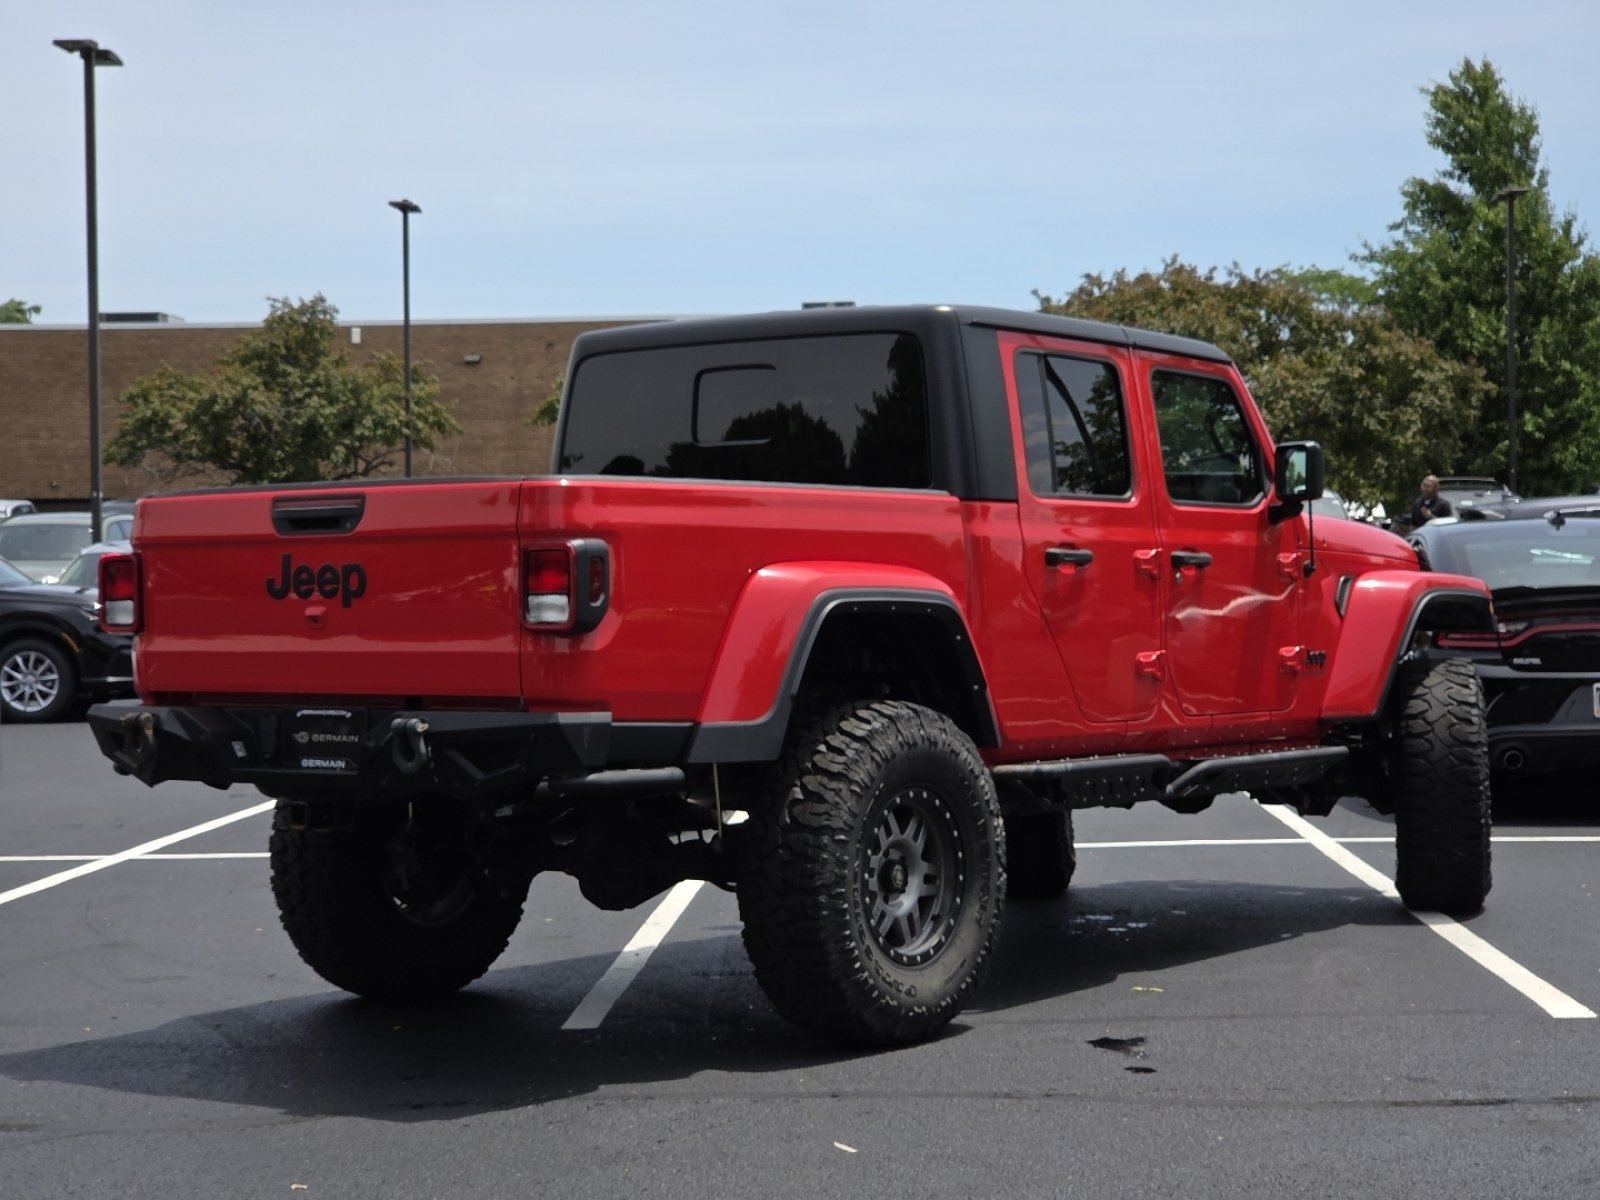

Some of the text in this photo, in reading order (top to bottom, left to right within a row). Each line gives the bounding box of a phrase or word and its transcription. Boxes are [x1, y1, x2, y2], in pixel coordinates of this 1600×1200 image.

[266, 552, 367, 608] Jeep
[311, 733, 359, 743] GERMAIN
[300, 758, 346, 769] GERMAIN
